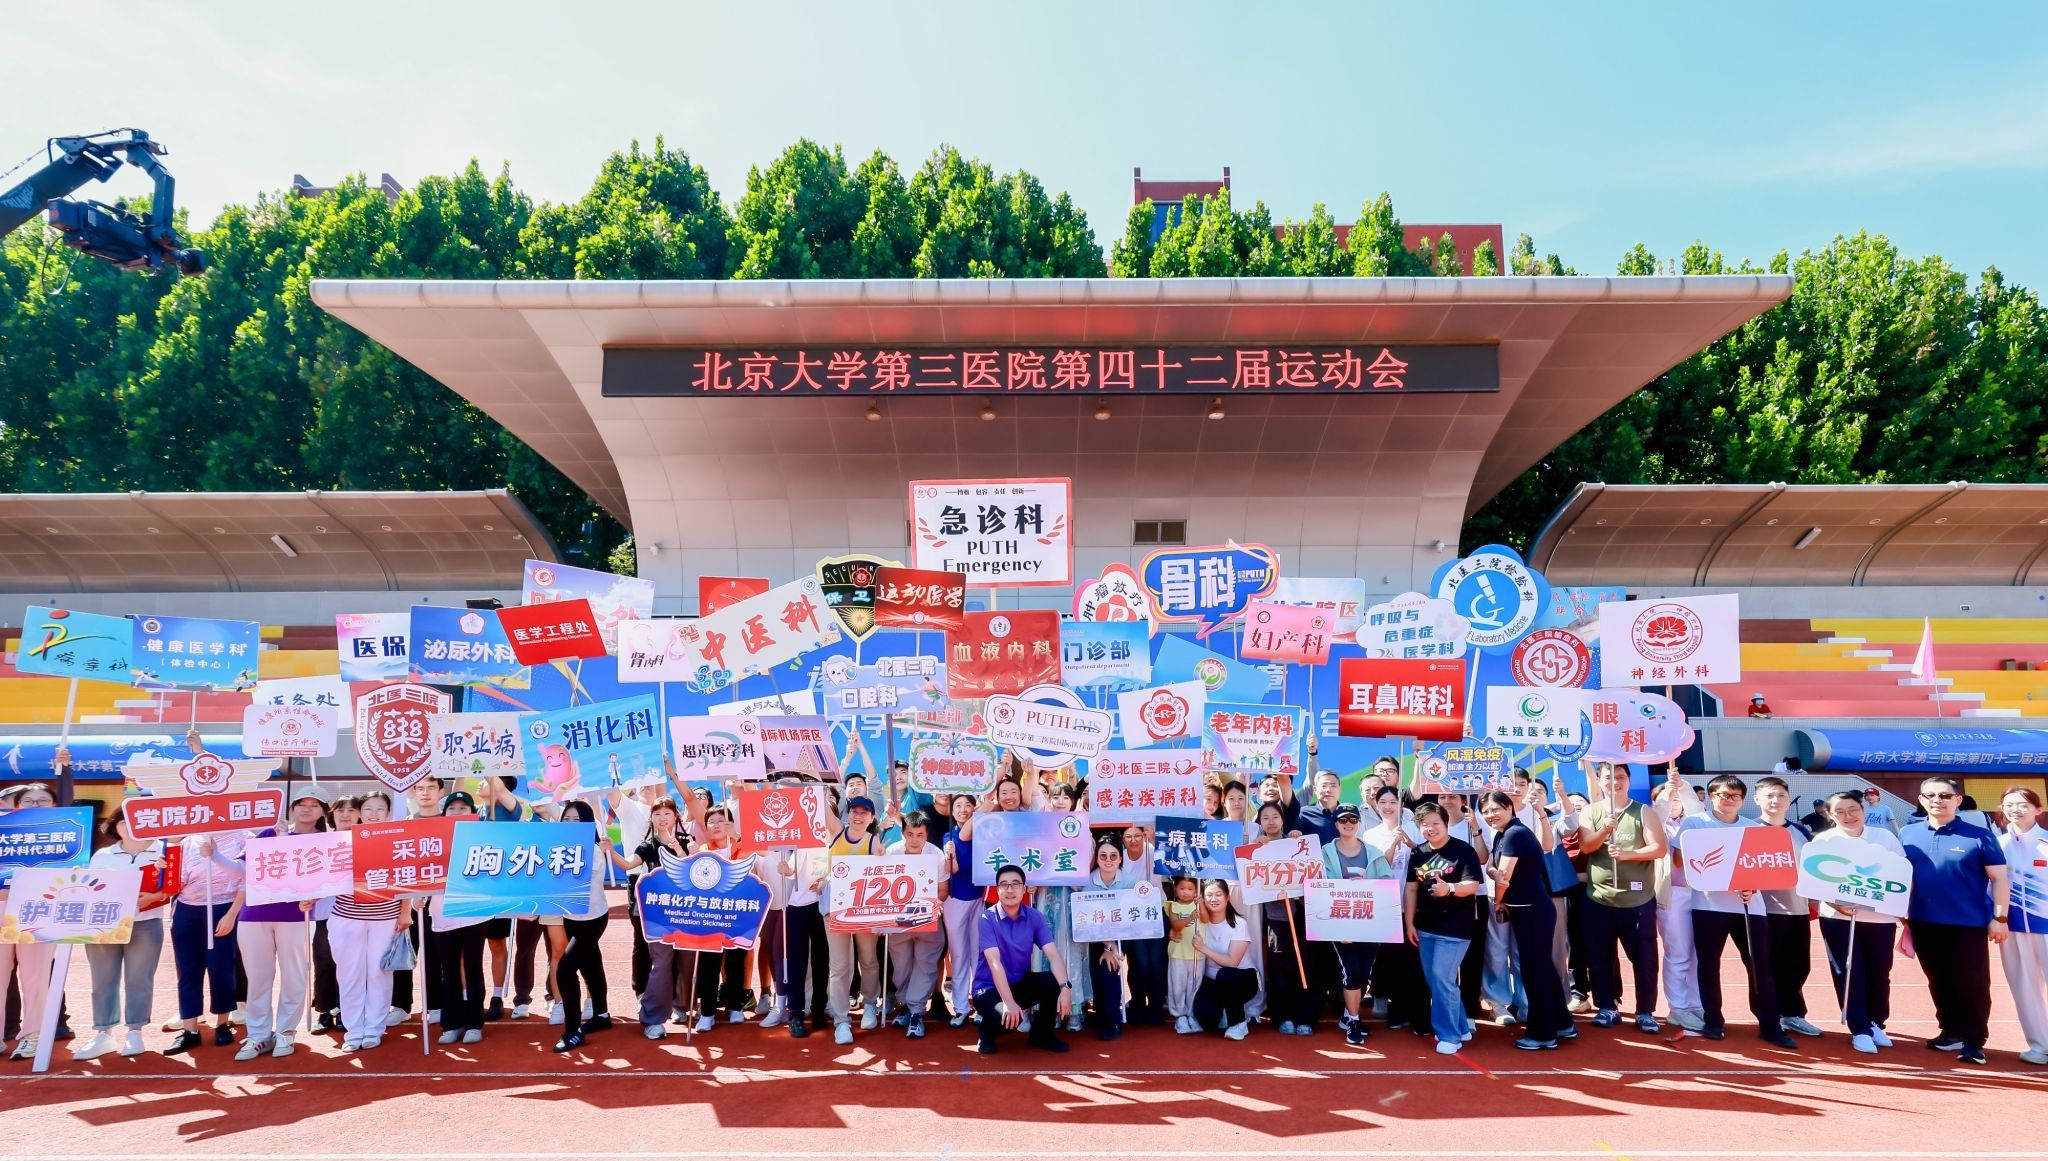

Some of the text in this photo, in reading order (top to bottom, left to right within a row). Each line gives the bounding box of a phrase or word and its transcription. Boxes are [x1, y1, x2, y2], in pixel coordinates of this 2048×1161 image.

[691, 349, 1409, 391] 北京大学第三医院第四十二届运动会
[939, 503, 1044, 535] 急诊科
[967, 540, 1018, 555] PUTH
[943, 558, 1043, 575] Emergency
[1246, 569, 1265, 578] PUTH
[1160, 555, 1237, 611] 骨科
[825, 590, 872, 606] 保卫
[876, 583, 964, 608] 运动医学
[1371, 609, 1420, 626] 呼吸与
[513, 620, 591, 641] 医学工程处
[699, 594, 823, 671] 中医科
[1384, 625, 1434, 643] 危重症
[1471, 615, 1529, 644] Laboratory Medicine
[146, 638, 249, 657] 健康医学科
[353, 635, 406, 658] 医保
[423, 638, 516, 665] 泌尿外科
[953, 640, 1052, 662] 血液内科
[1064, 640, 1131, 663] 门诊部
[1250, 628, 1324, 656] 妇产科
[1403, 642, 1454, 659] 医学科
[629, 650, 664, 669] 肾内科
[1645, 650, 1672, 661] University
[1673, 646, 1688, 660] Third
[877, 659, 936, 678] 北医三院
[1631, 665, 1710, 680] 神经外科
[841, 686, 898, 709] 口腔科
[1348, 683, 1455, 716] 耳鼻喉科
[1026, 710, 1070, 729] PUTH
[1210, 711, 1293, 736] 老年内科
[1592, 702, 1618, 726] 眼
[561, 707, 654, 750] 消化科
[1498, 726, 1570, 739] 生殖医学科
[443, 729, 516, 759] 职业病
[682, 743, 757, 758] 超声医学科
[1620, 729, 1648, 753] 科
[1446, 747, 1503, 762] 风湿免疫
[1859, 751, 2048, 766] 北京大学第三医院第四十二届运
[372, 763, 388, 779] Third
[415, 760, 432, 778] Depar
[921, 757, 986, 778] 神经内科
[1117, 762, 1171, 778] 北医三院
[1096, 788, 1197, 808] 感染疾病科
[134, 797, 276, 830] 党院办、团委
[754, 828, 802, 842] 核医学科
[1168, 830, 1230, 851] 病理科
[392, 836, 443, 861] 采购
[254, 844, 354, 882] 接诊室
[461, 844, 586, 877] 胸外科
[863, 863, 906, 877] 北医三院
[984, 848, 1079, 873] 手术室
[1161, 858, 1235, 870] Pathology Department
[1738, 850, 1796, 870] 心内科
[364, 862, 444, 891] 管理中
[1245, 861, 1324, 888] 内分泌
[1803, 853, 1908, 894] CSSD
[850, 875, 917, 908] 120
[1329, 891, 1375, 899] 中央党校院区
[1837, 883, 1886, 902] 供应室
[19, 898, 121, 925] 护理部
[645, 892, 761, 913] 肿瘤化疗与放射病科
[1329, 899, 1375, 920] 最靓
[664, 908, 690, 917] Medical
[691, 910, 723, 921] Oncology
[670, 917, 732, 929] Radiation Sickness
[1075, 905, 1160, 926] 全科医学科
